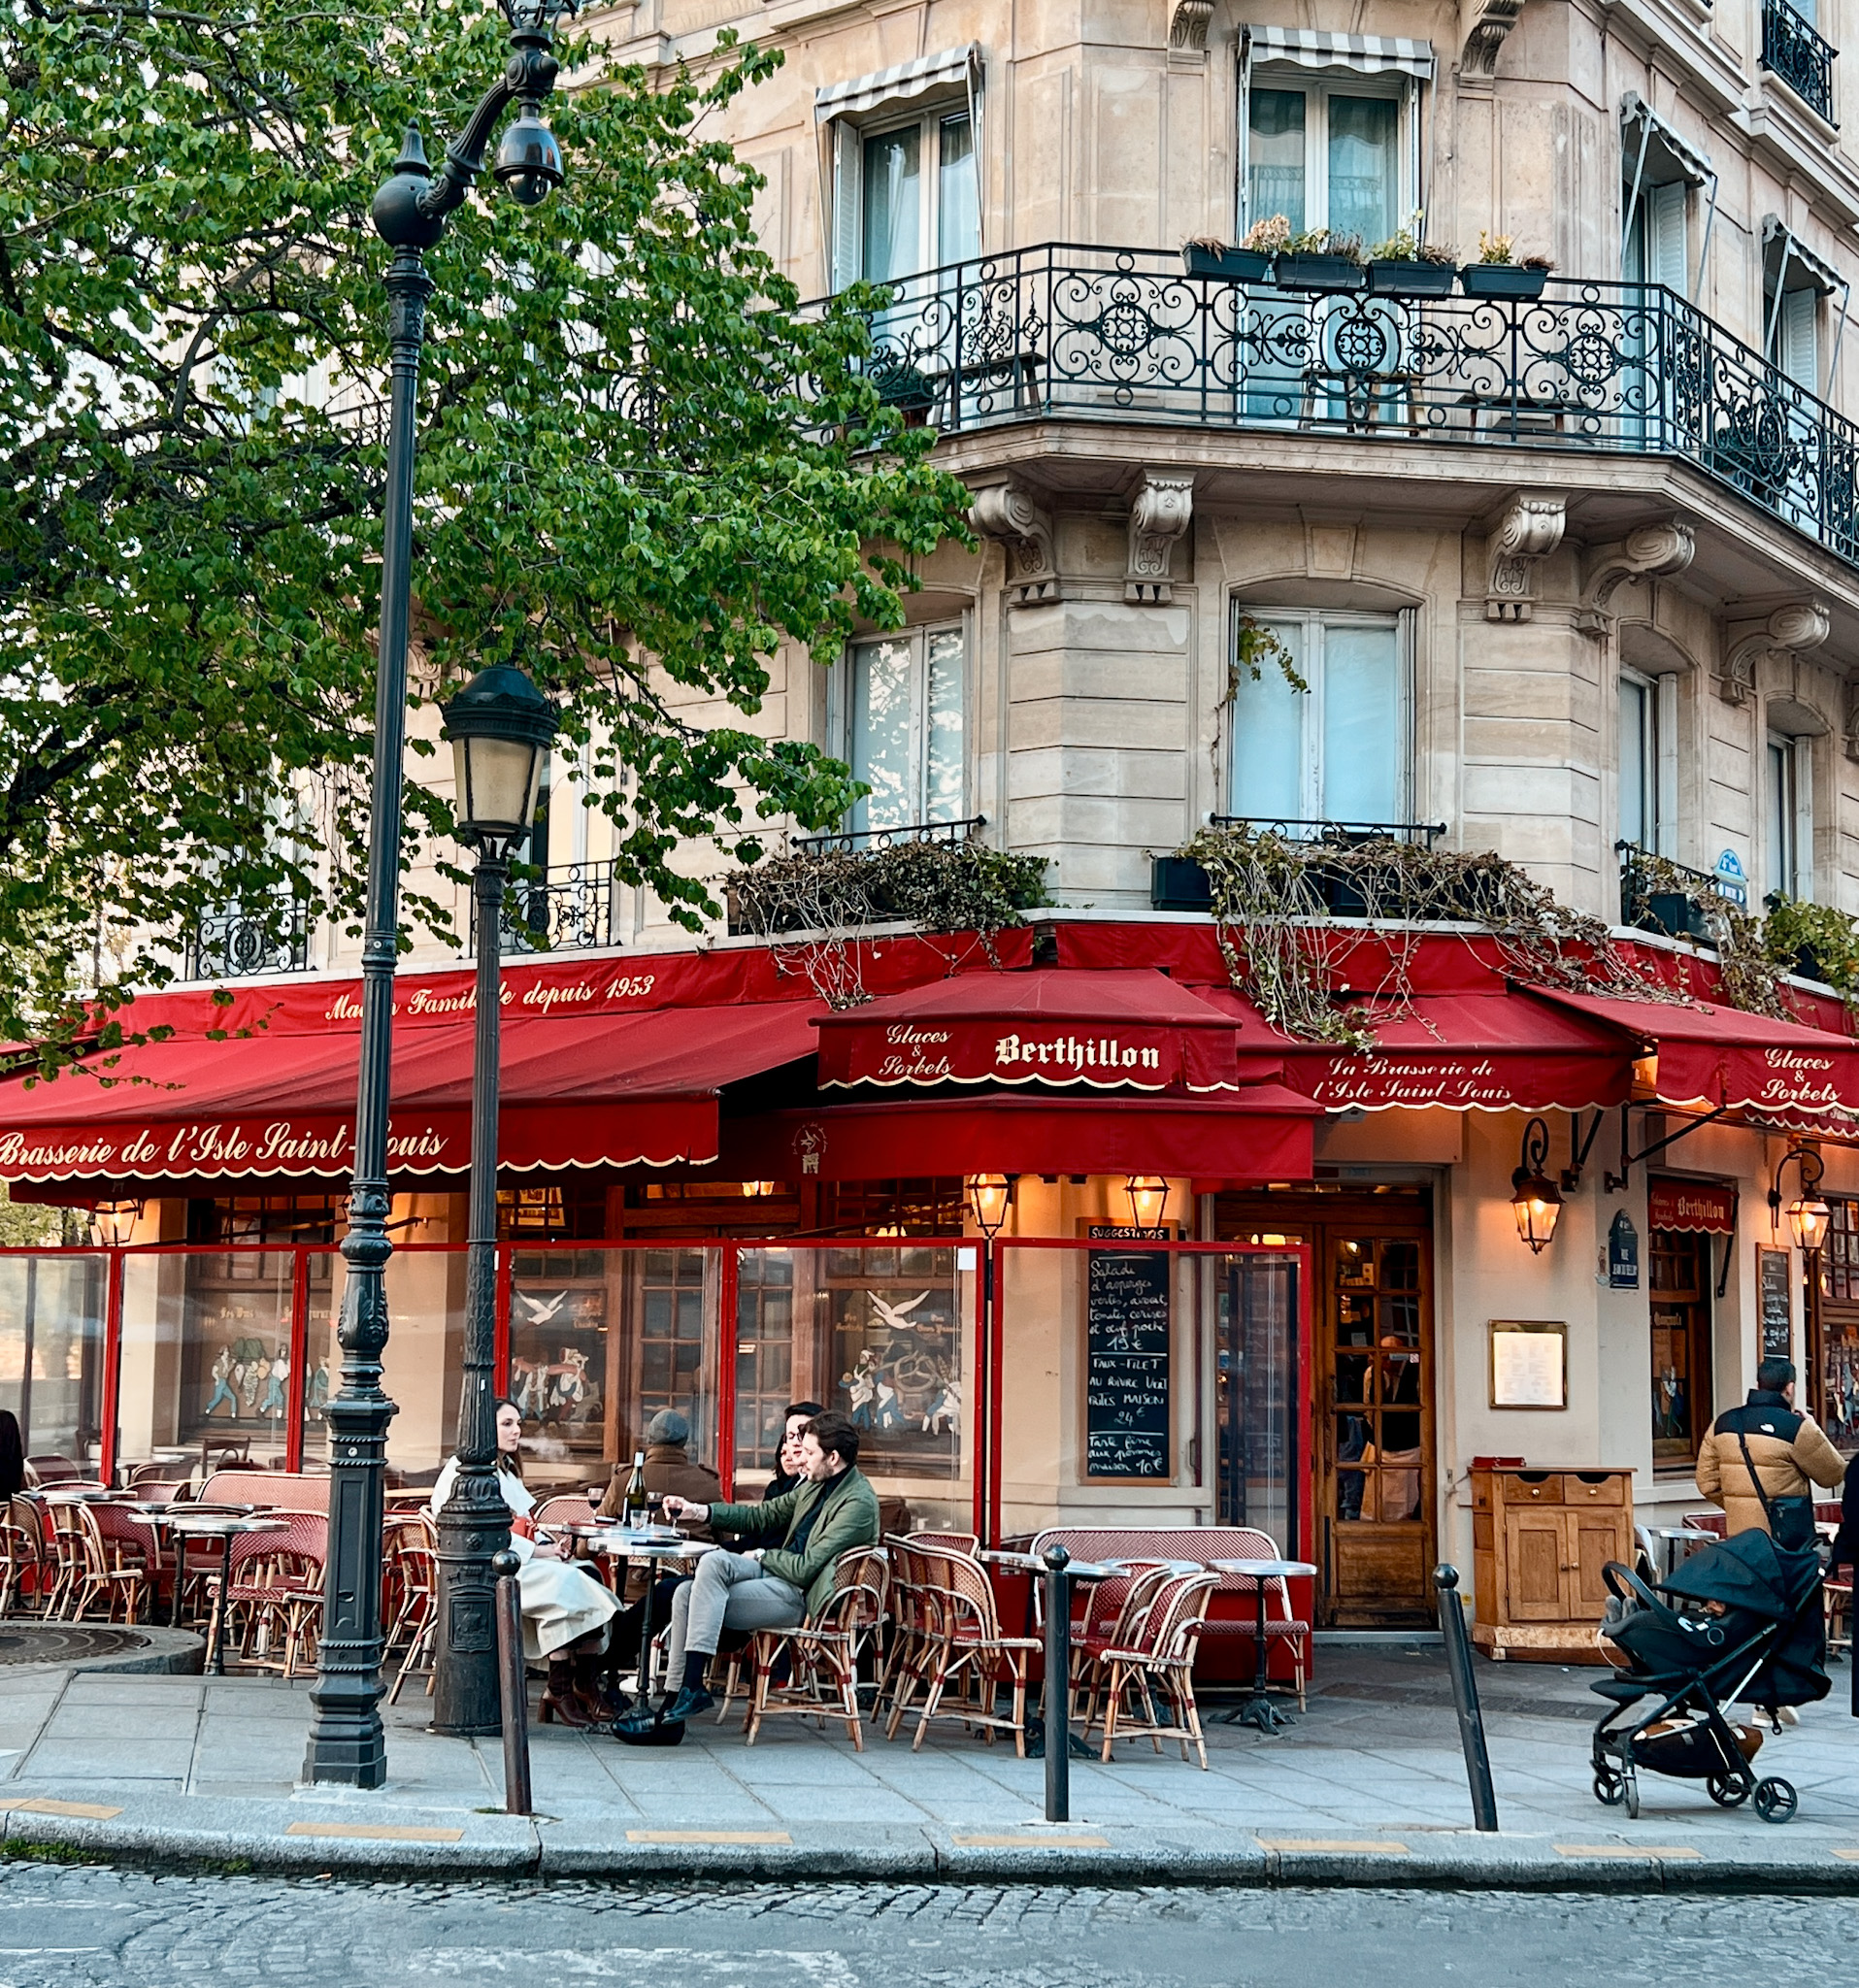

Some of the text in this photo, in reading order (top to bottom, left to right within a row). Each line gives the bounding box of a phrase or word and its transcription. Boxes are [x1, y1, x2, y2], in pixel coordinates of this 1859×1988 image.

[522, 979, 598, 1013] depuis
[606, 975, 655, 998] 1953
[887, 1024, 953, 1044] Glaces
[912, 1044, 922, 1057] &
[995, 1034, 1160, 1071] Berthillon
[1764, 1048, 1835, 1070] Glaces
[879, 1055, 955, 1076] Sorbets
[1329, 1057, 1496, 1077] La Brasserie de
[1794, 1069, 1806, 1082] &
[1312, 1079, 1513, 1100] l'Isle Saint-Louis
[1760, 1078, 1842, 1101] Sorbets
[0, 1119, 449, 1166] Brasserie de l'Isle Saint-ouis
[1677, 1195, 1725, 1220] Berthillon
[1090, 1260, 1136, 1278] Salade
[1123, 1393, 1165, 1406] MAISON
[1088, 1435, 1153, 1450] Tarte fine
[1088, 1449, 1111, 1458] aux
